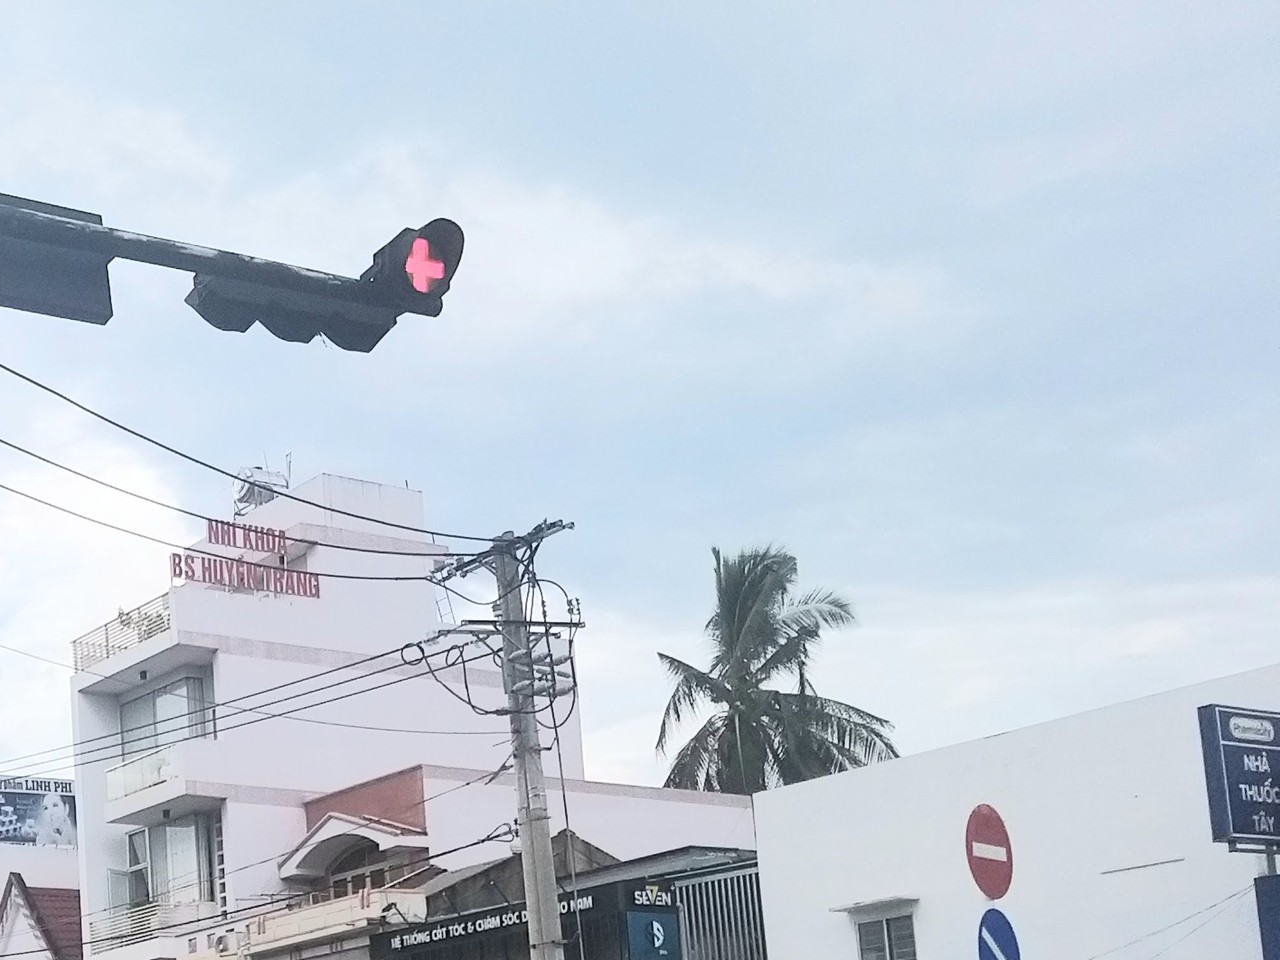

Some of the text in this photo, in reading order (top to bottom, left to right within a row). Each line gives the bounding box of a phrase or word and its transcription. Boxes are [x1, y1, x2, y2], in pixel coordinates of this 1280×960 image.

[208, 520, 288, 554] NHI KHOA
[172, 553, 196, 581] BS
[264, 566, 320, 599] TRANG
[25, 780, 52, 792] LINH
[53, 781, 73, 793] PHI
[1252, 810, 1275, 833] TÂY
[634, 885, 672, 906] SEVEN
[467, 922, 474, 934] &
[570, 895, 593, 912] NAM
